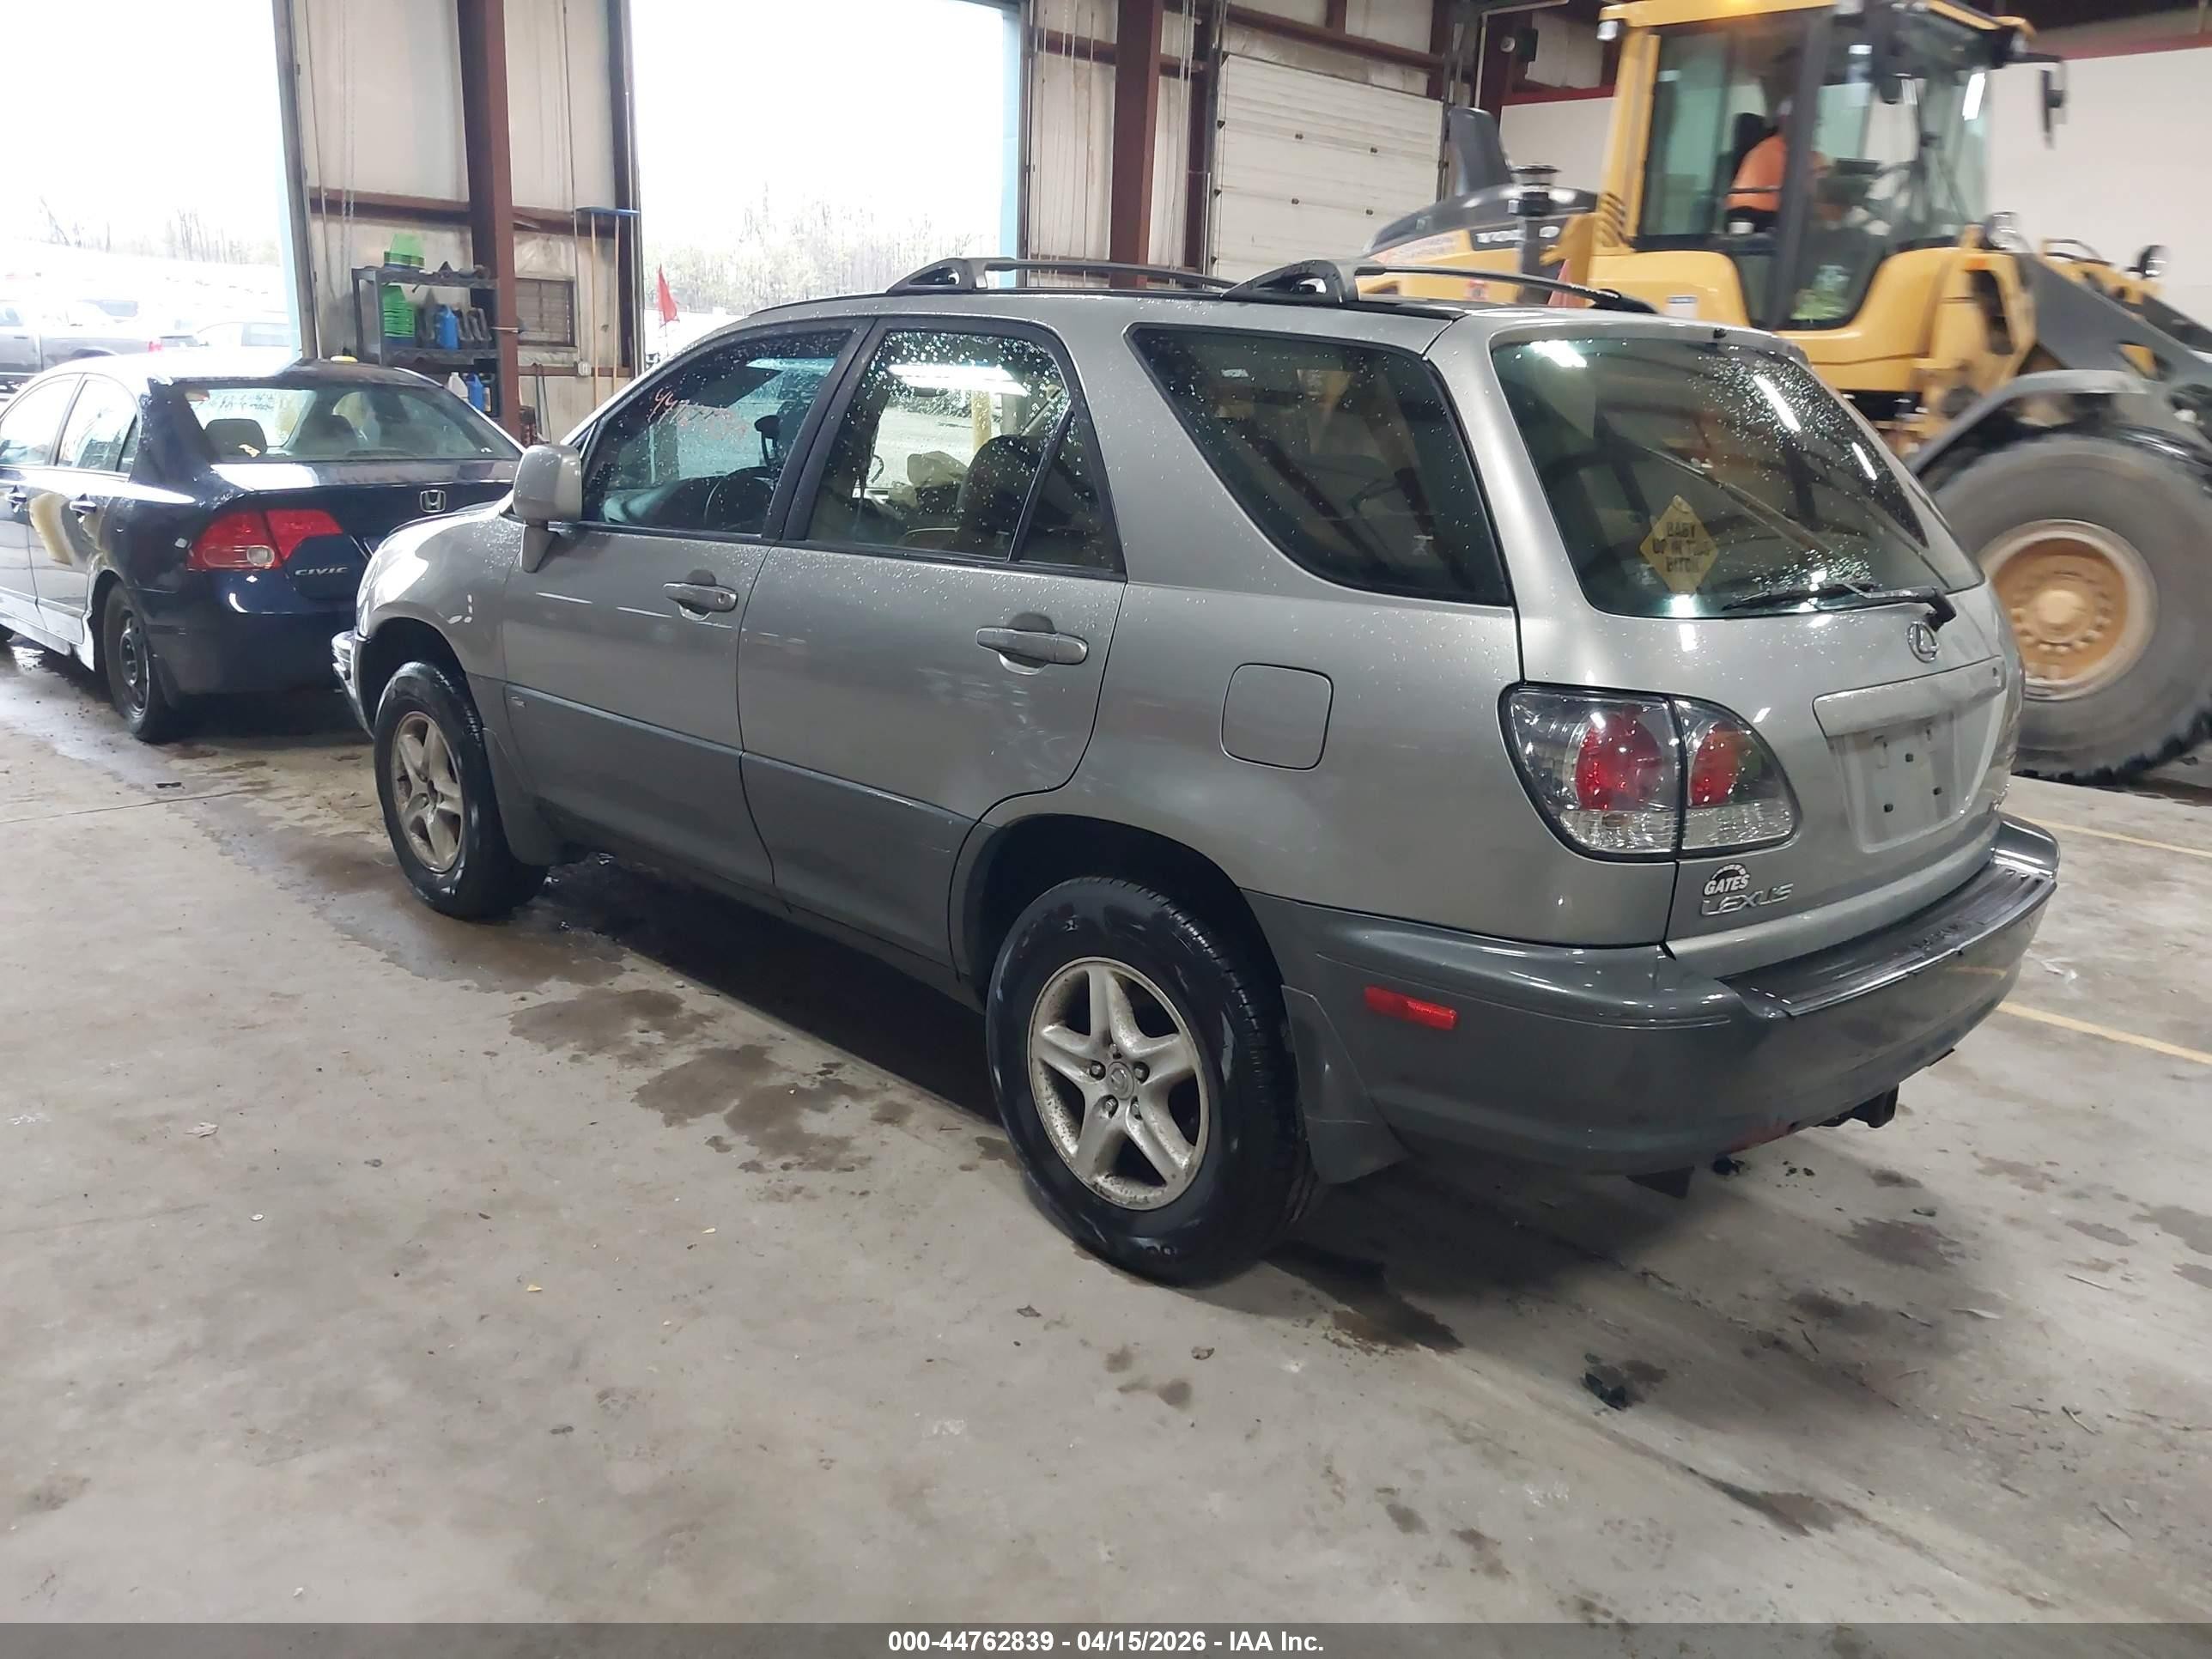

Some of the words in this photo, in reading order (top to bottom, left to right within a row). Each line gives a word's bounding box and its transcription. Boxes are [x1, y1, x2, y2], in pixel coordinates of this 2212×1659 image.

[295, 567, 349, 575] CIVIC
[1704, 874, 1751, 896] GATES
[1701, 883, 1794, 915] LEXUS
